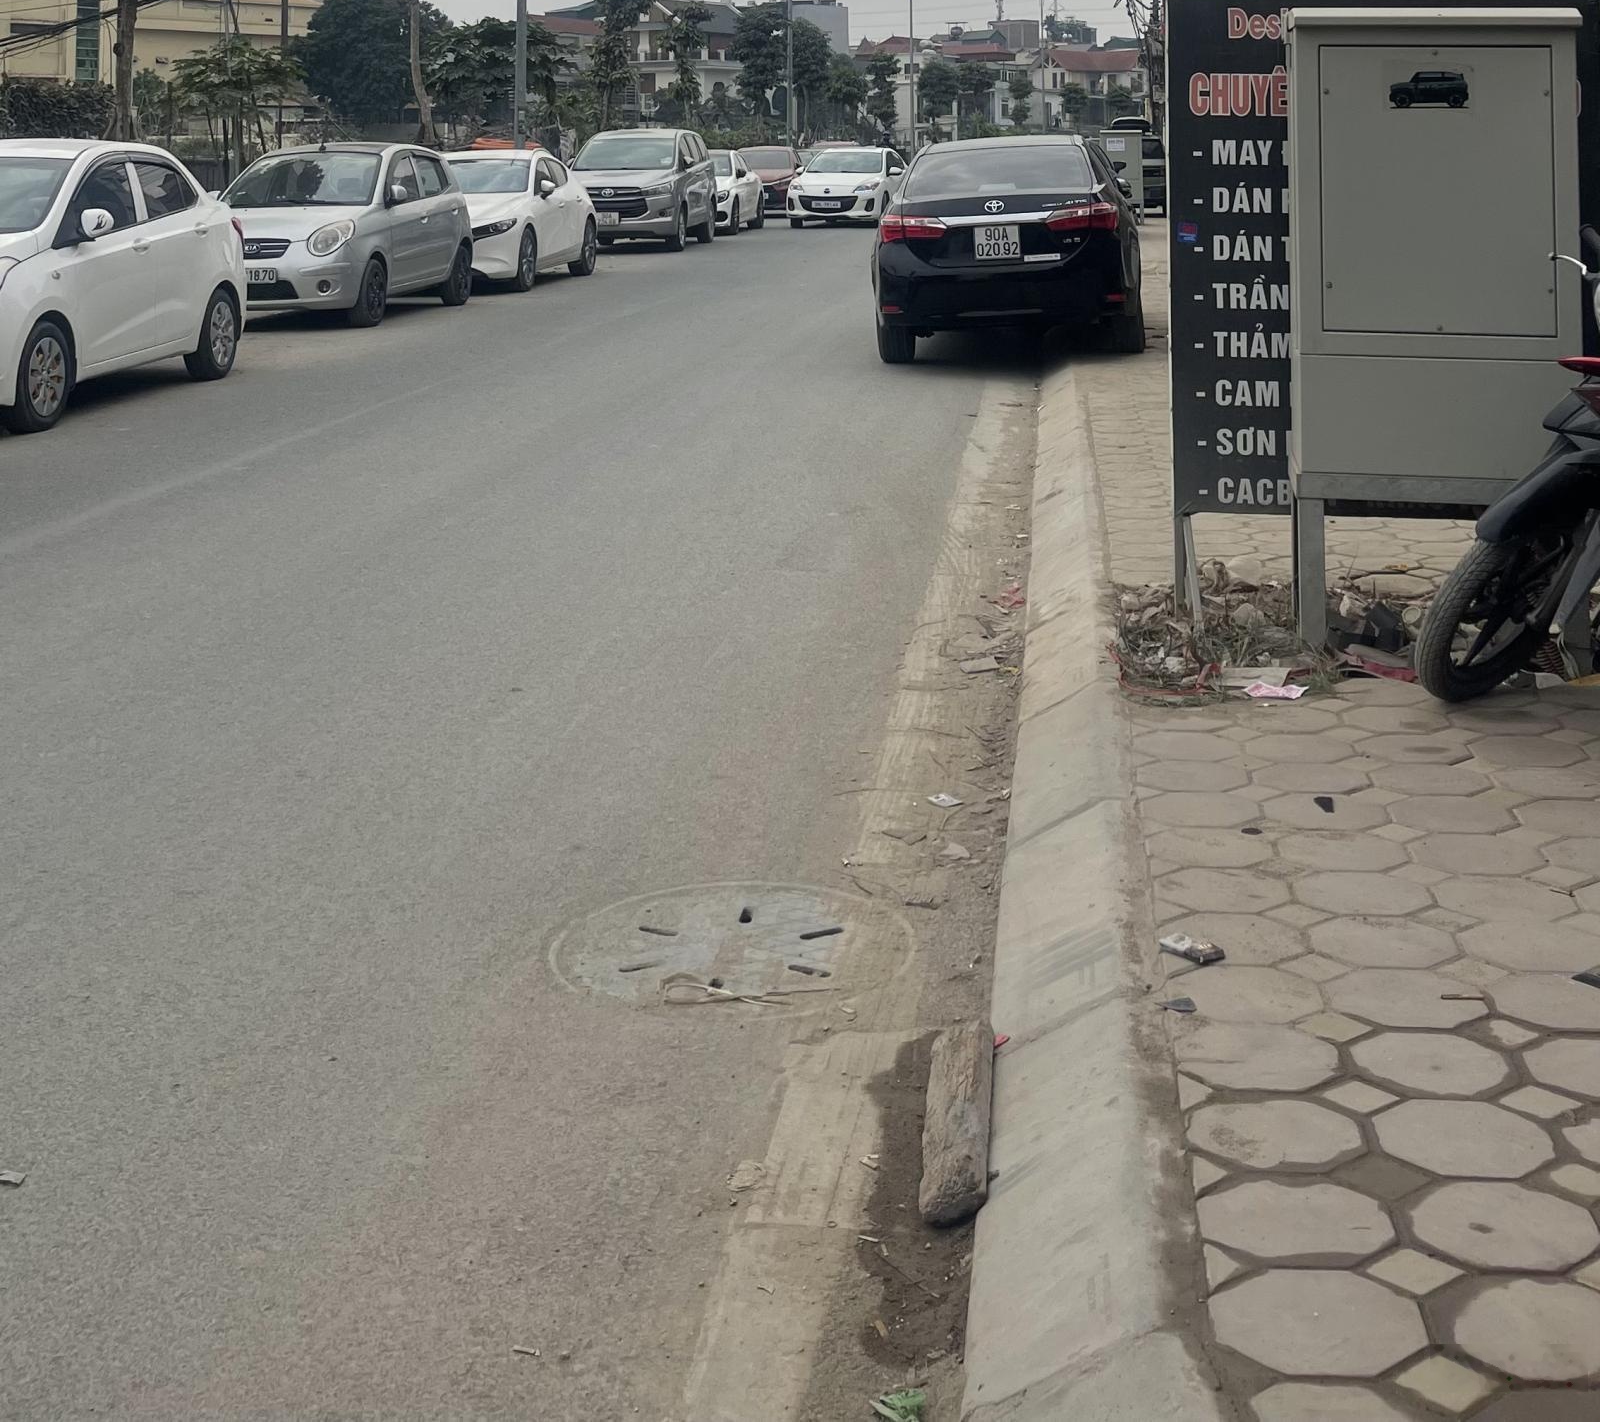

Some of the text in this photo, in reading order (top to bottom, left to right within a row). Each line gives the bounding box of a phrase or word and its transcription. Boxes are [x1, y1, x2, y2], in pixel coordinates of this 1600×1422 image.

[1212, 140, 1273, 166] MAY
[1212, 182, 1272, 214] DÁN
[984, 227, 1009, 241] 90A
[1213, 230, 1273, 262] DÁN
[976, 242, 1019, 257] 020.92
[1212, 275, 1289, 310] TRẦN
[1213, 323, 1290, 359] THẢM
[1215, 380, 1280, 407] CAM
[1216, 427, 1276, 456] SƠN
